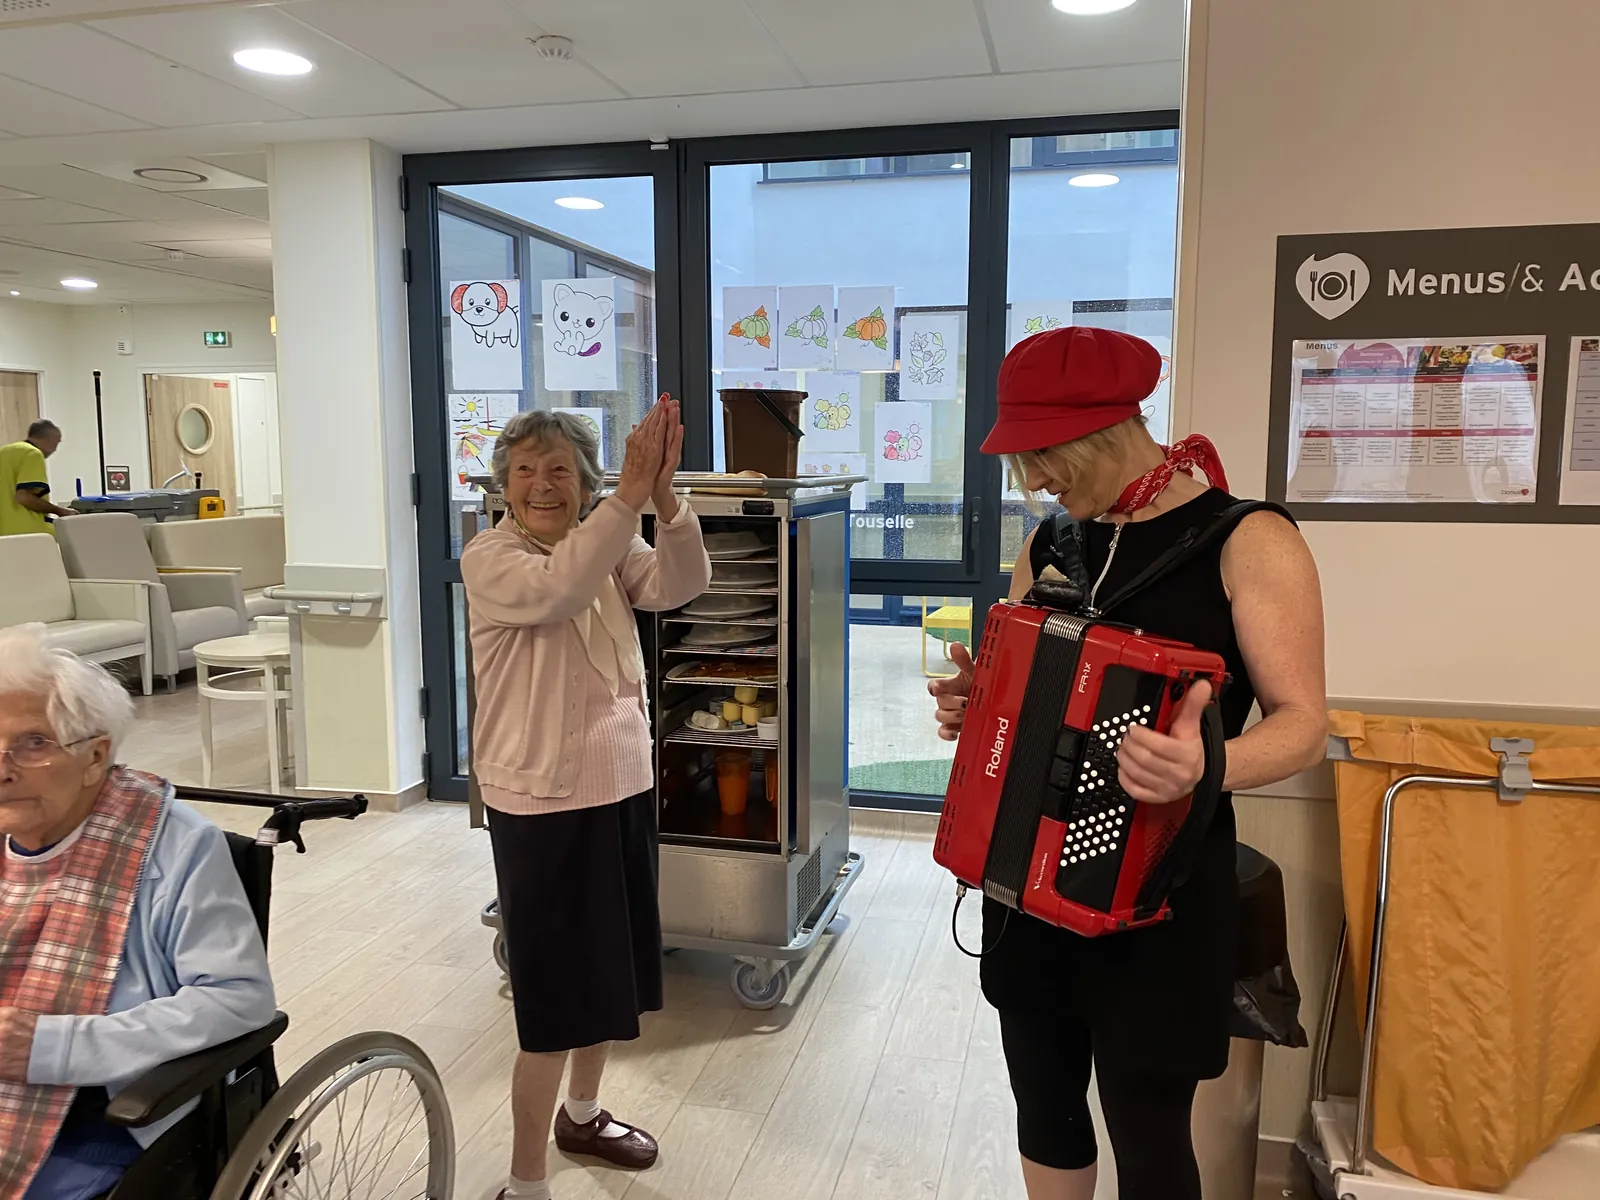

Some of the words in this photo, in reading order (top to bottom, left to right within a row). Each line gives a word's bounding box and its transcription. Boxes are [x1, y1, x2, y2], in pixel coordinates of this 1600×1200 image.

[1387, 268, 1505, 297] Menus
[1521, 263, 1544, 293] &
[1306, 342, 1339, 350] Menus
[985, 716, 1010, 778] Roland
